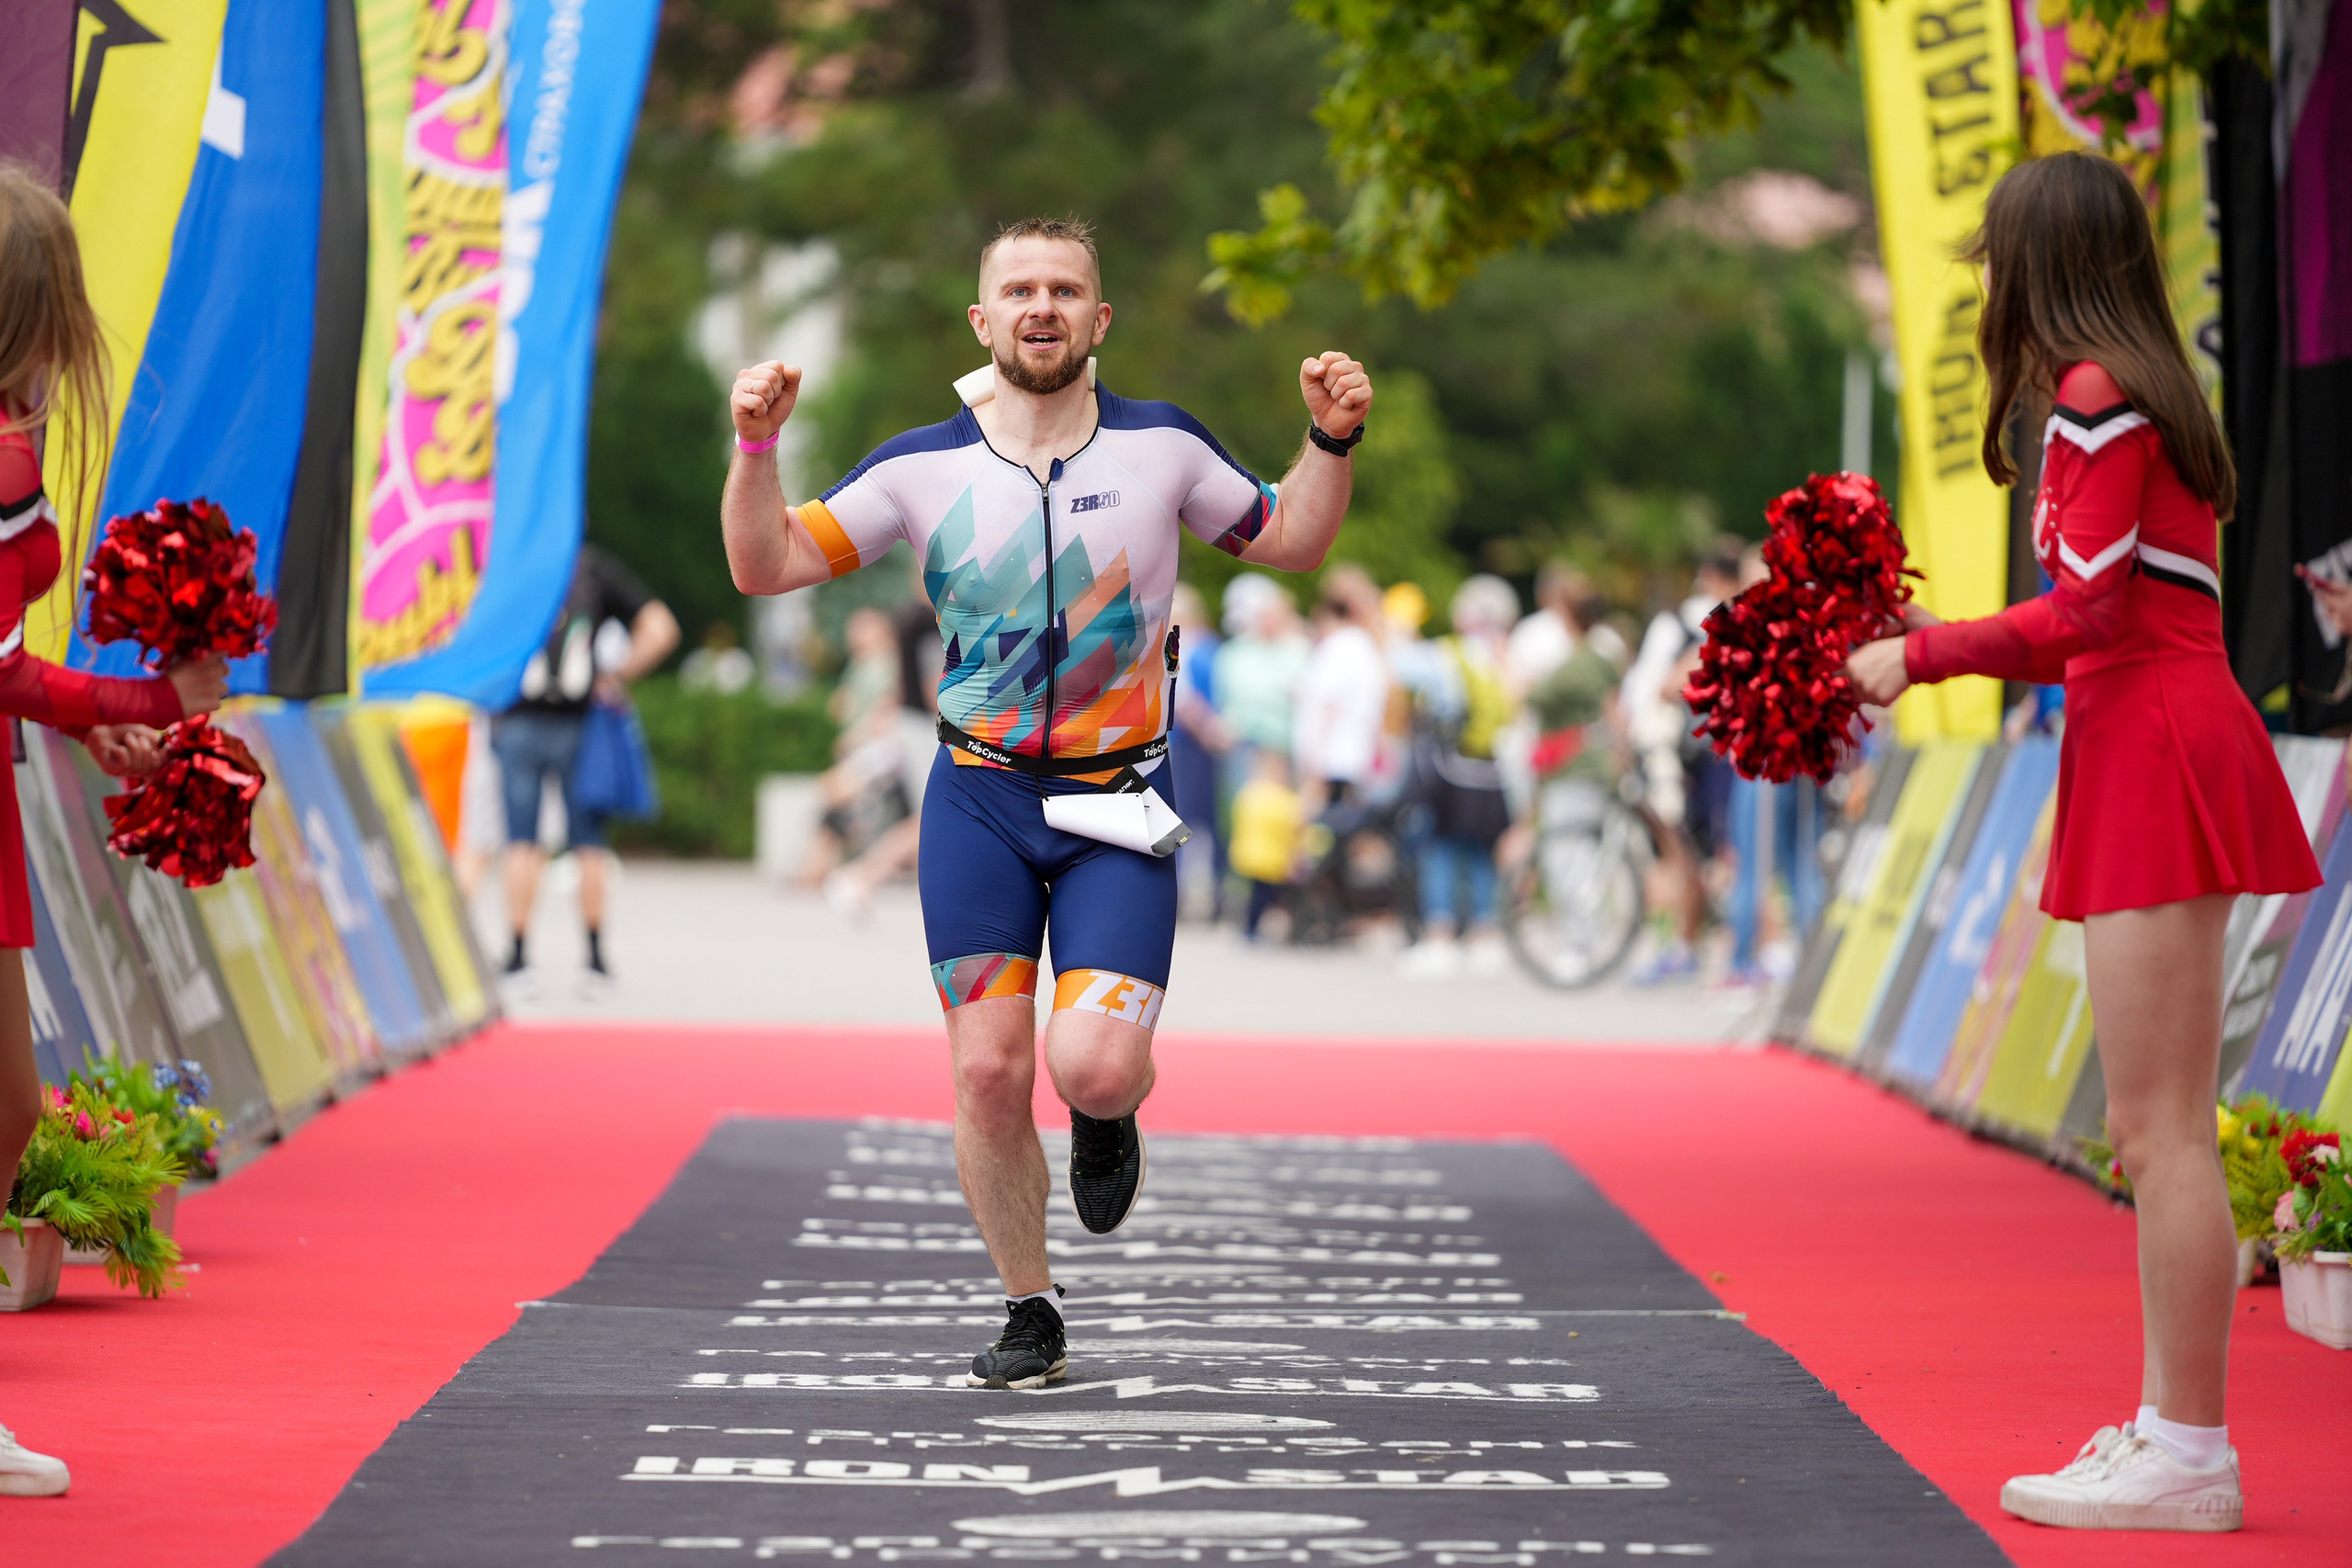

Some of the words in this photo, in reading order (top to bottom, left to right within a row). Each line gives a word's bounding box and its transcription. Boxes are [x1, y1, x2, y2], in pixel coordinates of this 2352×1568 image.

[967, 740, 1012, 764] TopCycler
[690, 1372, 967, 1388] IRO
[1227, 1377, 1600, 1399] STAR
[633, 1455, 1031, 1482] IRON
[1244, 1468, 1671, 1484] STAR
